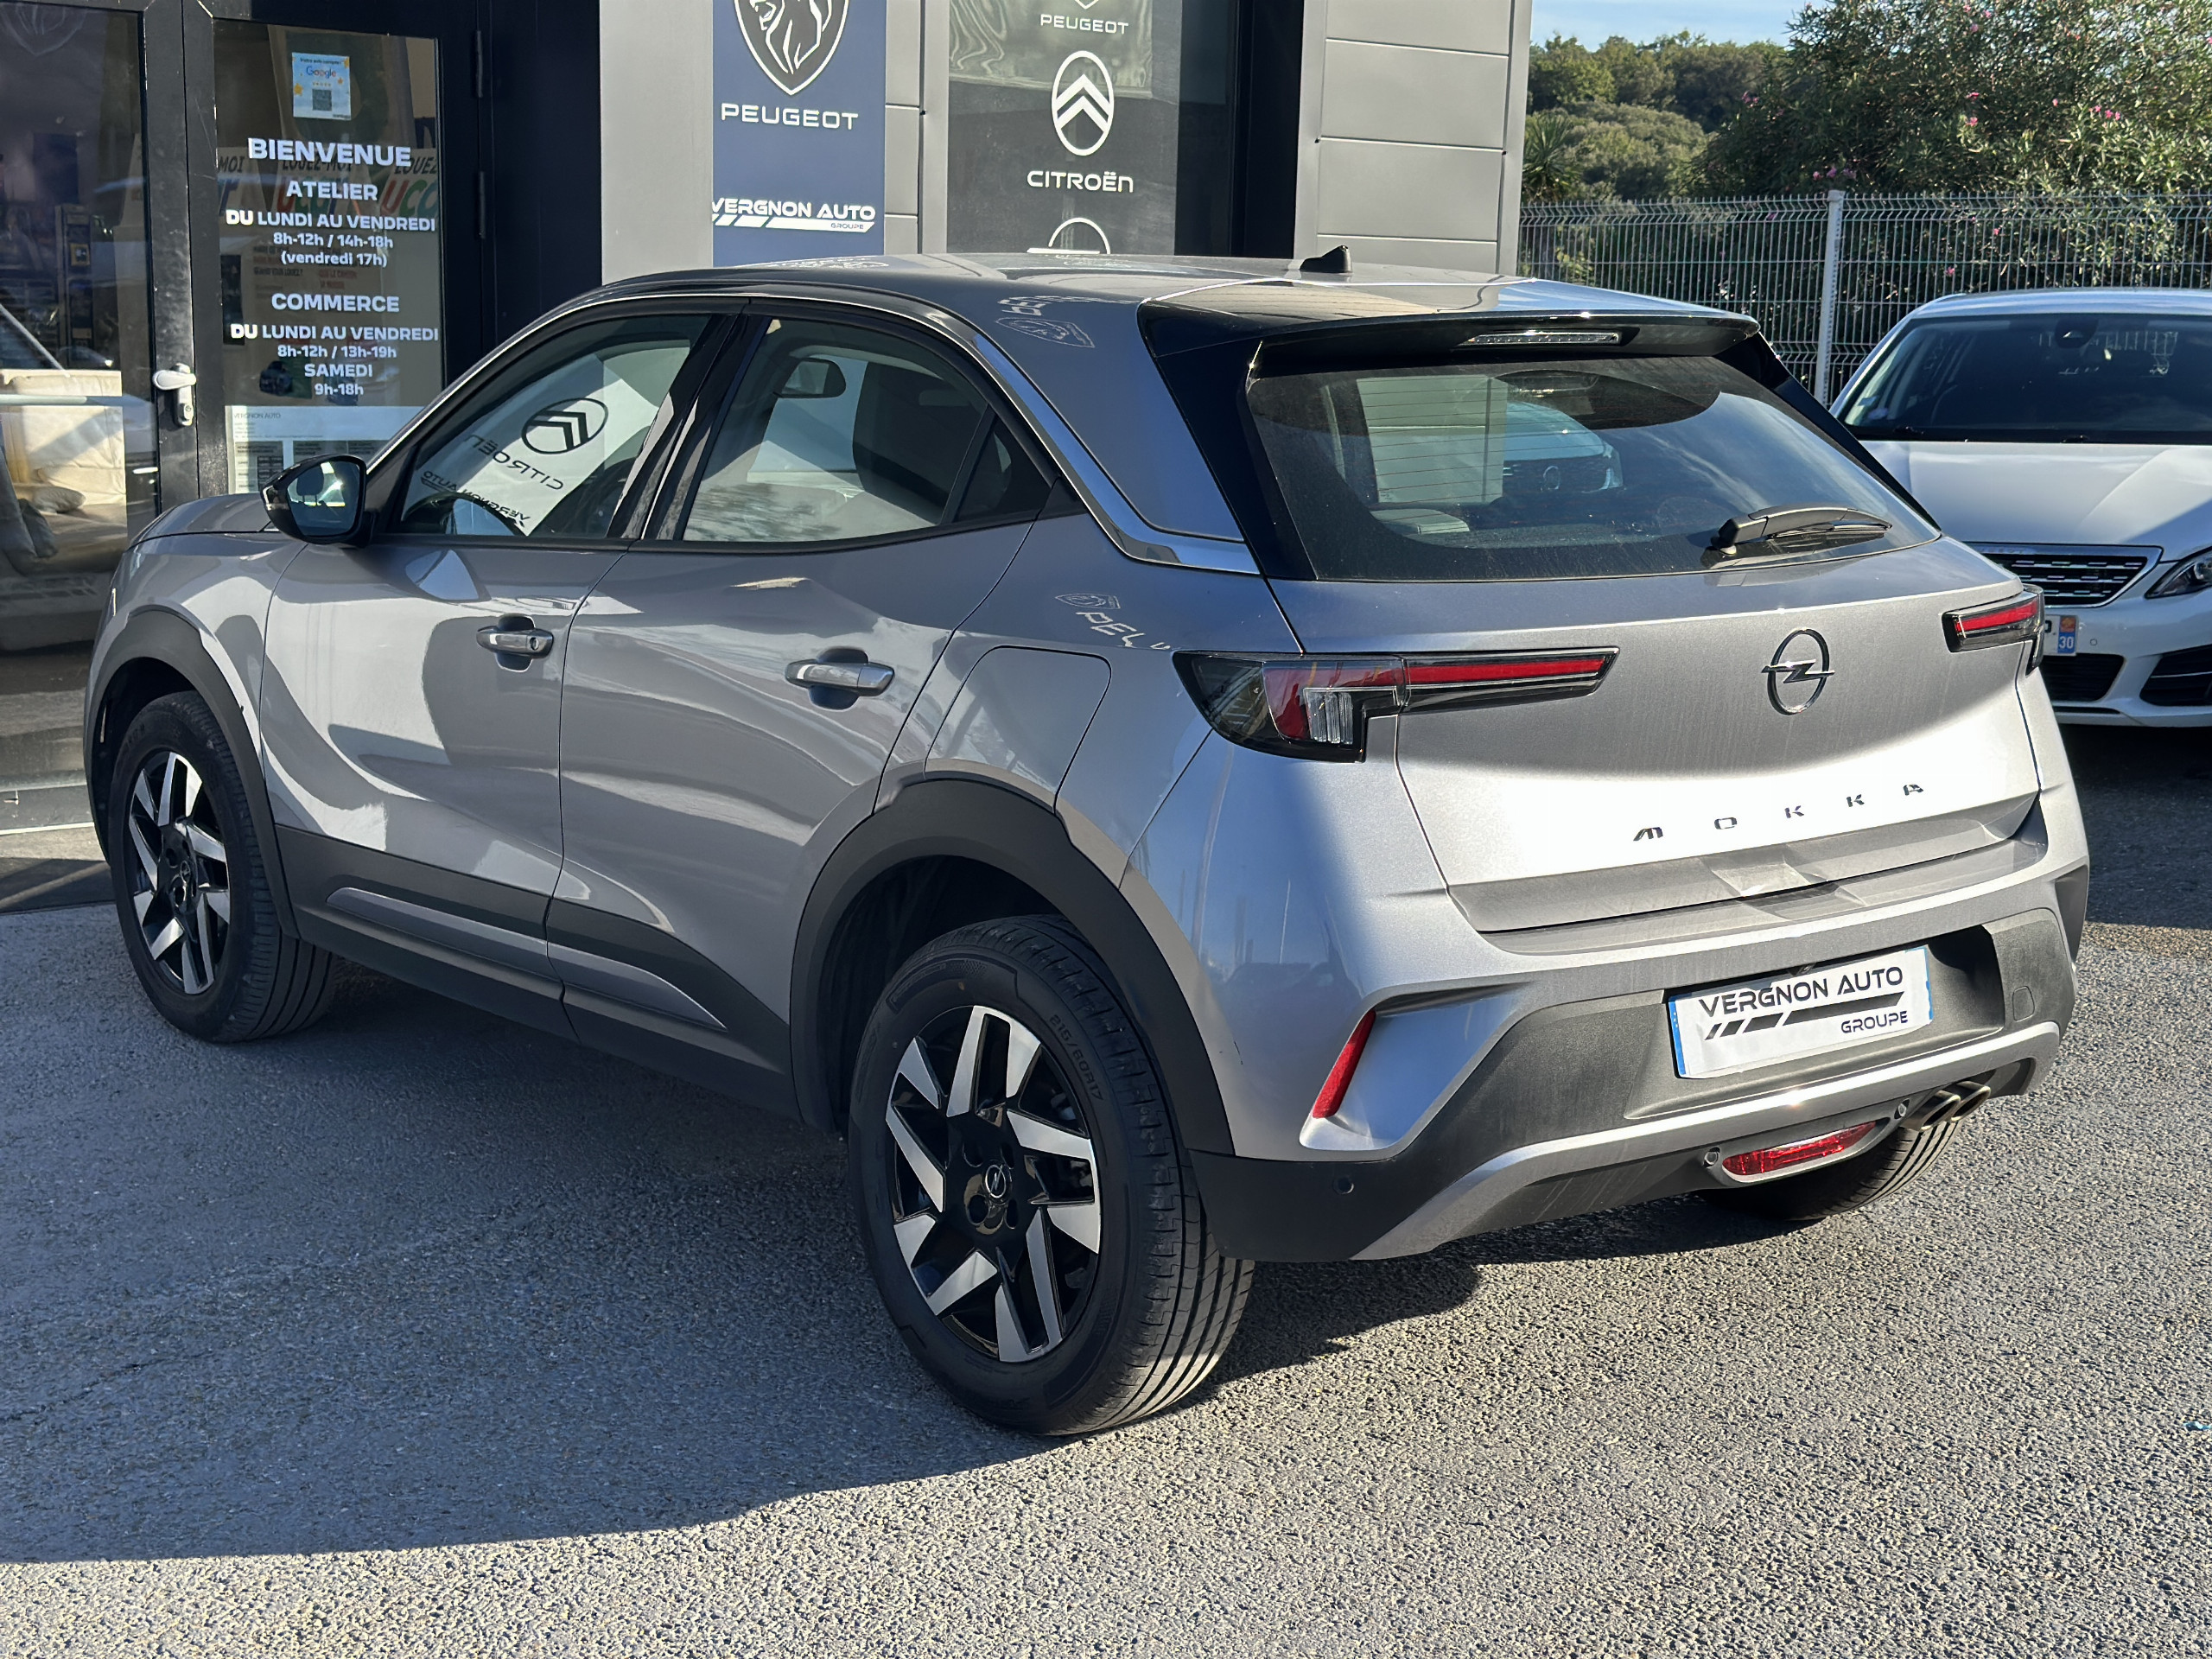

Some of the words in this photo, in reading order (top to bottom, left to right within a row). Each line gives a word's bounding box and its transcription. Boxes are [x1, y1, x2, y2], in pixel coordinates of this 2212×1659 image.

[1040, 14, 1128, 35] PEUGEOT
[306, 65, 337, 79] Google
[721, 102, 859, 130] PEUGEOT
[248, 137, 411, 167] BIENVENUE
[286, 180, 378, 201] ATELIER
[1027, 170, 1134, 194] CITROËN
[712, 197, 812, 218] VERGNON
[817, 204, 876, 220] AUTO
[226, 209, 254, 225] DU
[257, 212, 313, 227] LUNDI
[316, 213, 342, 228] AU
[346, 214, 435, 232] VENDREDI
[273, 232, 324, 245] 8h-12h
[337, 234, 393, 249] 14h-18h
[281, 251, 353, 265] (vendredi
[357, 253, 388, 268] 17h)
[271, 293, 400, 313] COMMERCE
[230, 323, 258, 339] DU
[262, 324, 316, 340] LUNDI
[321, 325, 346, 340] AU
[350, 327, 439, 341] VENDREDI
[277, 345, 327, 358] 8h-12h
[341, 346, 397, 359] 13h-19h
[304, 363, 372, 378] SAMEDI
[314, 383, 364, 396] 9h-18h
[2058, 636, 2074, 649] 30
[1633, 783, 1924, 842] MOKKA
[1699, 978, 1828, 1017] VERGNON
[1837, 967, 1904, 995] AUTO
[1841, 1010, 1909, 1034] GROUPE
